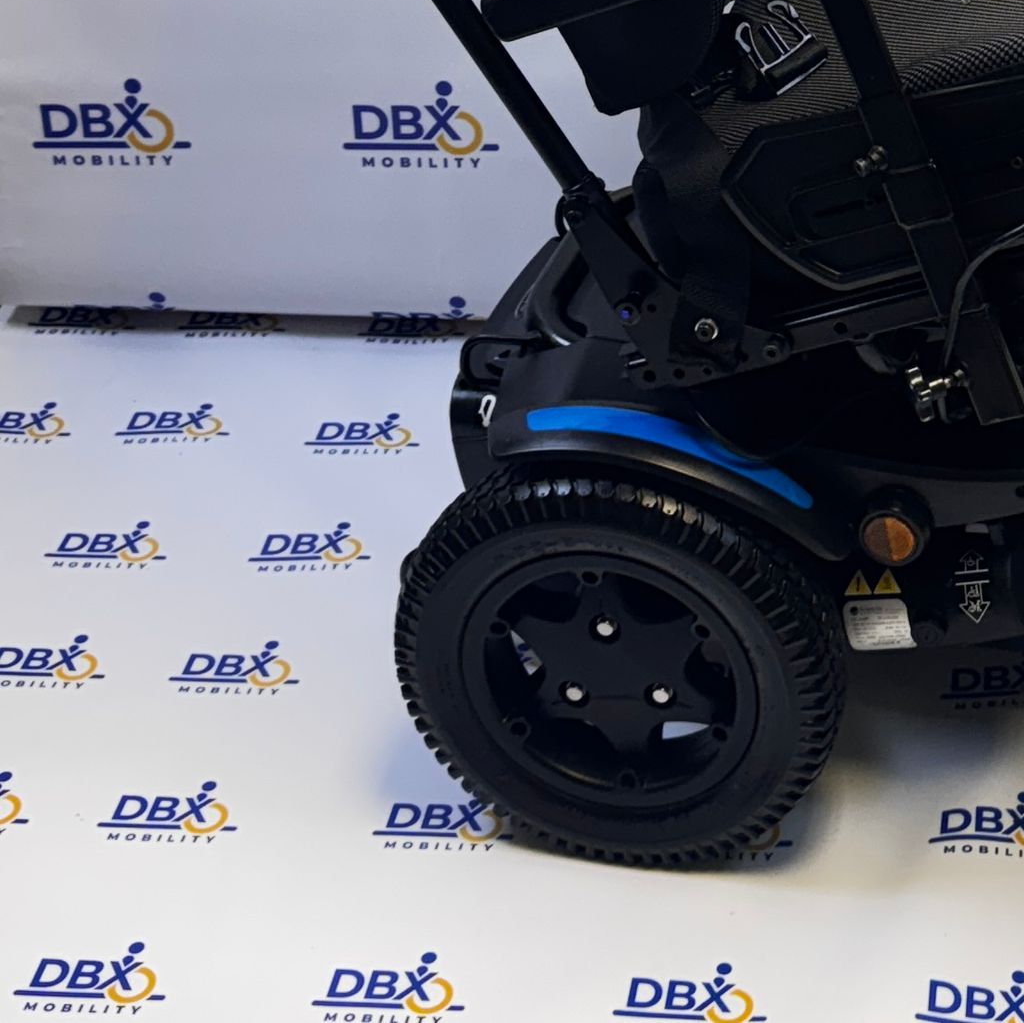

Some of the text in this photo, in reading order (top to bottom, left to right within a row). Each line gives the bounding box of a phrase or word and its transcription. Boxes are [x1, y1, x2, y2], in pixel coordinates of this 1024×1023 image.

[40, 103, 152, 138] DBX
[352, 105, 461, 140] DBX
[53, 155, 172, 165] MOBILITY
[362, 157, 480, 168] MOBILITY
[0, 411, 55, 430] BX
[127, 410, 210, 430] DBX
[316, 420, 398, 440] DBX
[57, 531, 147, 553] DBX
[261, 532, 349, 555] DBX
[53, 561, 146, 569] MOBILITY
[258, 564, 352, 572] MOBILITY
[182, 651, 277, 677] DBX
[1, 680, 84, 689] OBILITY
[178, 686, 279, 695] MOBILITY
[112, 795, 215, 822] DBX
[386, 803, 489, 831] DBX
[107, 833, 215, 843] MOBILITY
[384, 841, 494, 851] MOBILITY
[30, 959, 142, 990] DBX
[327, 969, 437, 1001] DBX
[625, 977, 733, 1012] DBX
[24, 1002, 141, 1014] MOBILITY
